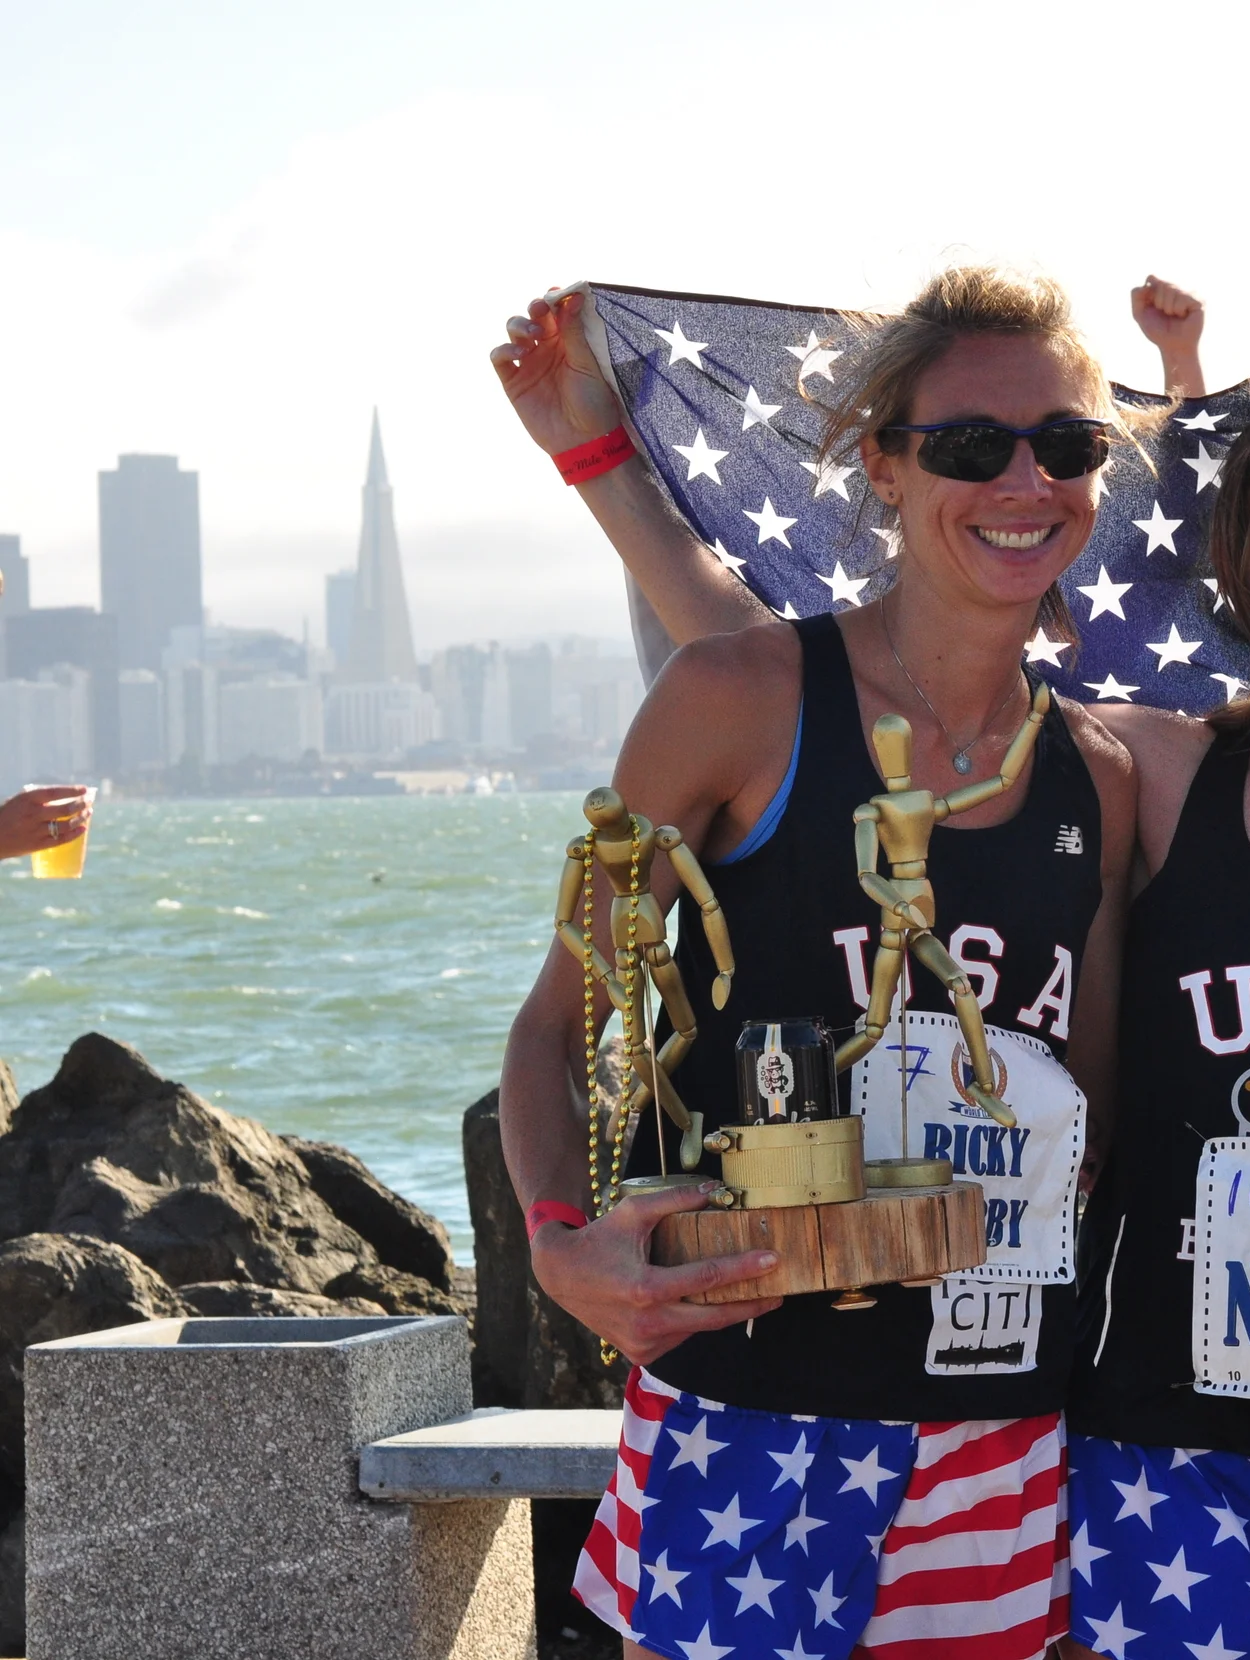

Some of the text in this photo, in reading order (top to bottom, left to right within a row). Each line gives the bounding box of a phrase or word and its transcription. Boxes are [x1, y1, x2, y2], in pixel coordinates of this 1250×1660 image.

[833, 923, 1073, 1041] USA
[885, 1044, 936, 1092] 7
[1228, 1370, 1241, 1381] 10
